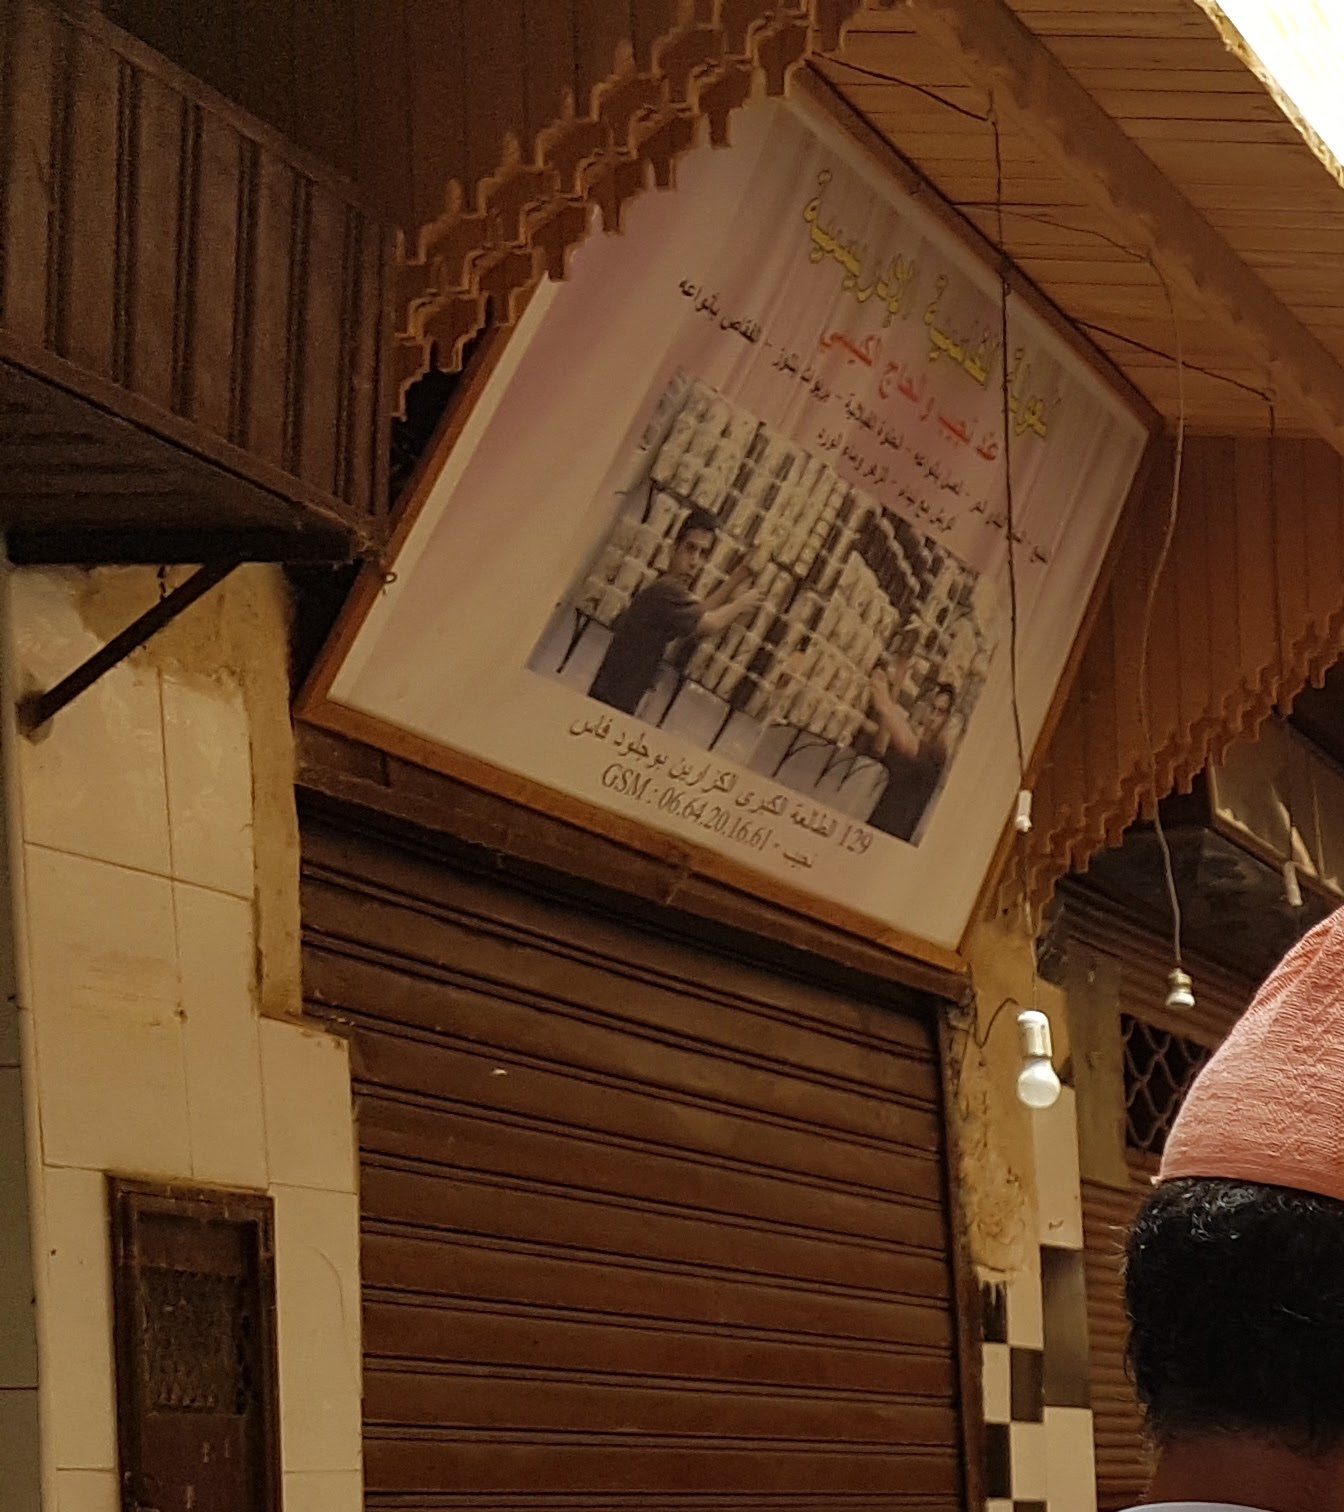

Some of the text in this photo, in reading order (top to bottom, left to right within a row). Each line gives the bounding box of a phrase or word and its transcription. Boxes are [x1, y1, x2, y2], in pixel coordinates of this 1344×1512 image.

[567, 715, 613, 740] فاس
[602, 763, 652, 800] GSM
[838, 825, 873, 854] 129
